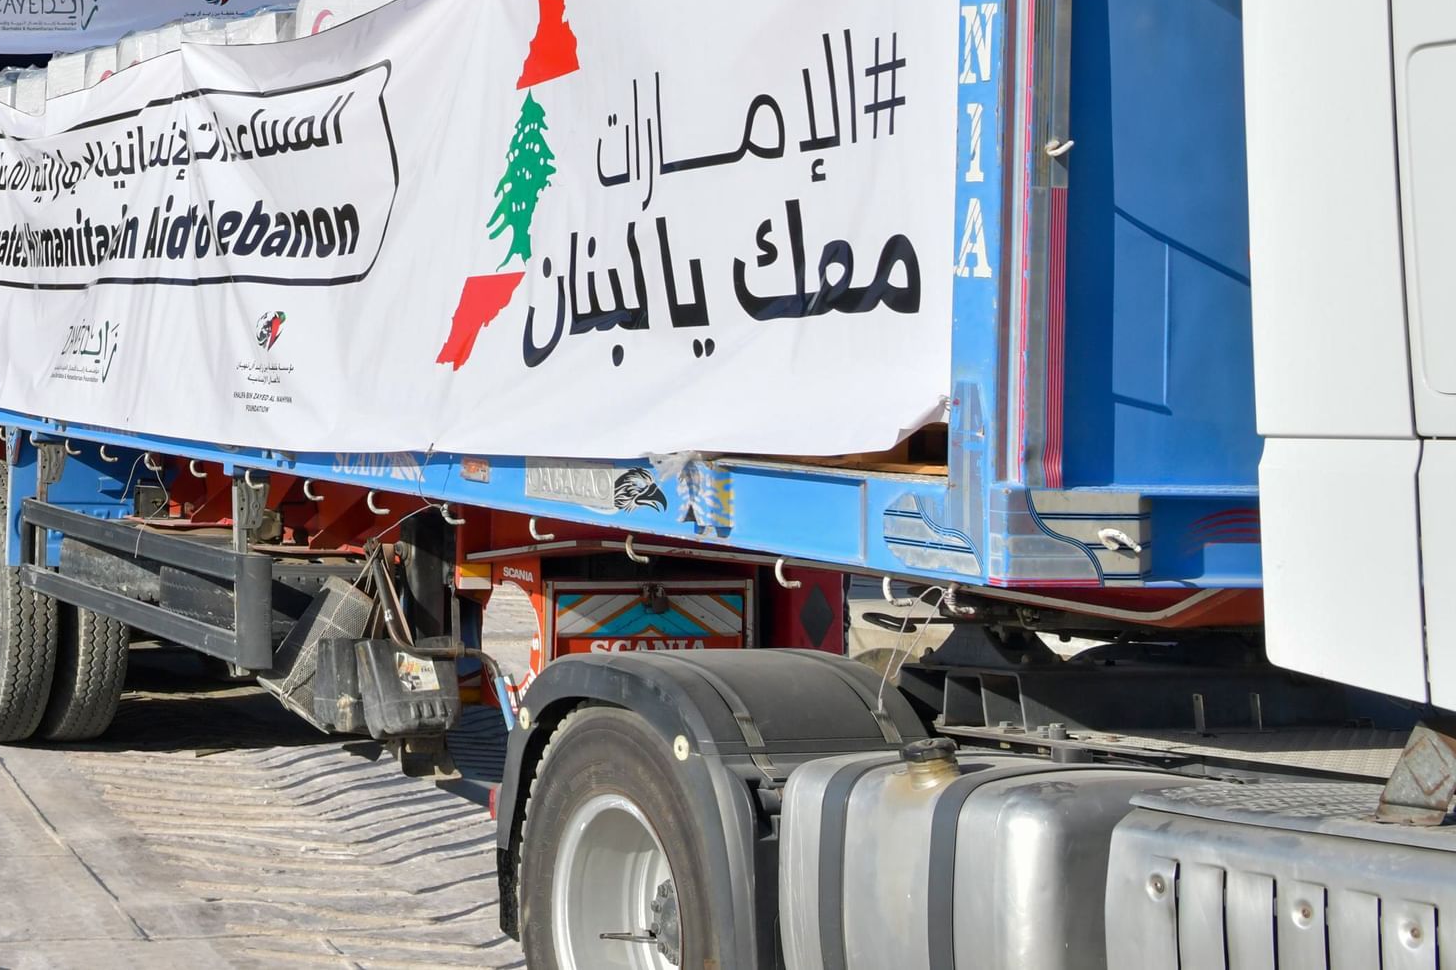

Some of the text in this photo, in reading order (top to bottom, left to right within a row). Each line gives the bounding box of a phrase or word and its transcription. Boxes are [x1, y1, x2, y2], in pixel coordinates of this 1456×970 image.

[522, 198, 922, 368] معك يا لبنان
[502, 566, 534, 583] SCANIA
